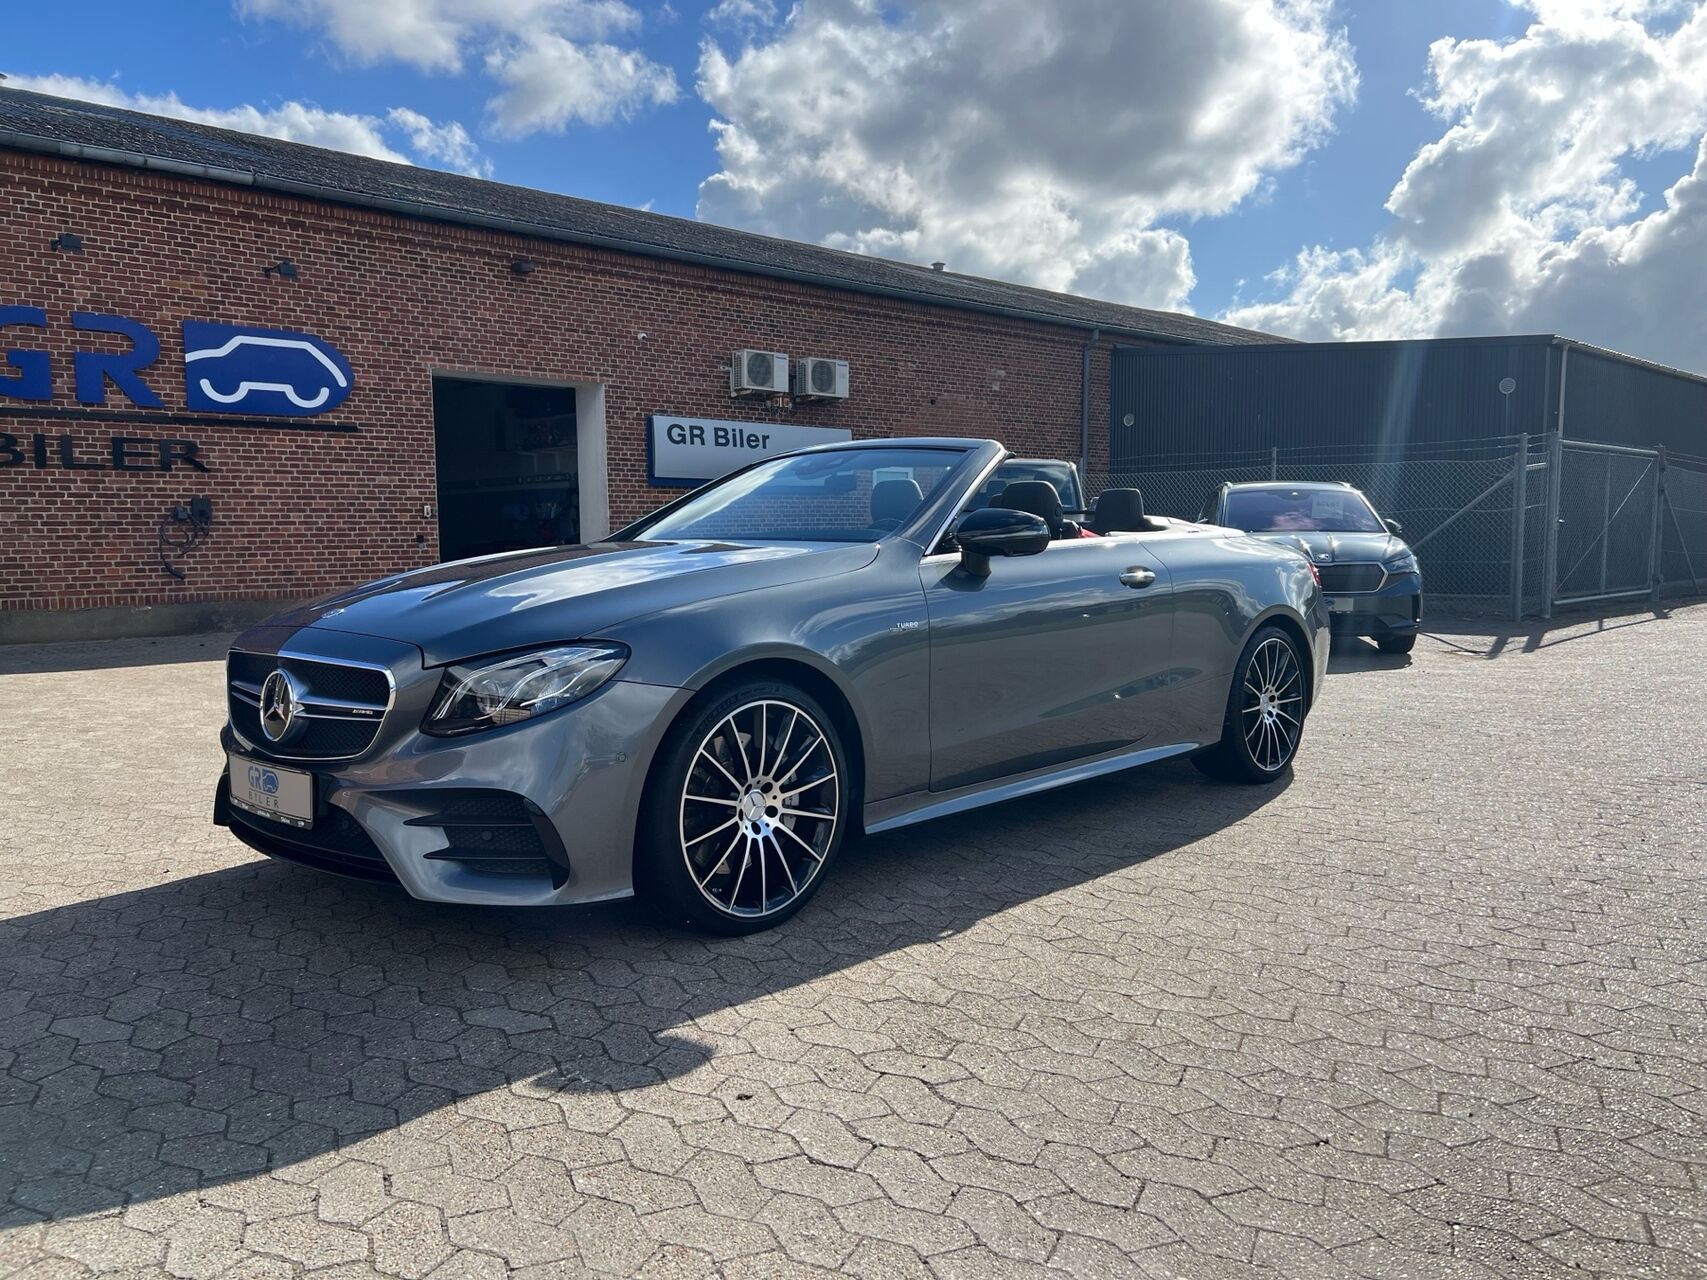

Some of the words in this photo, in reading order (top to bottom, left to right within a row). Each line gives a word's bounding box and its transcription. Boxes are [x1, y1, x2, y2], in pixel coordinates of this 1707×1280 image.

[0, 305, 165, 408] GR
[666, 423, 706, 446] GR
[713, 427, 770, 449] Biler
